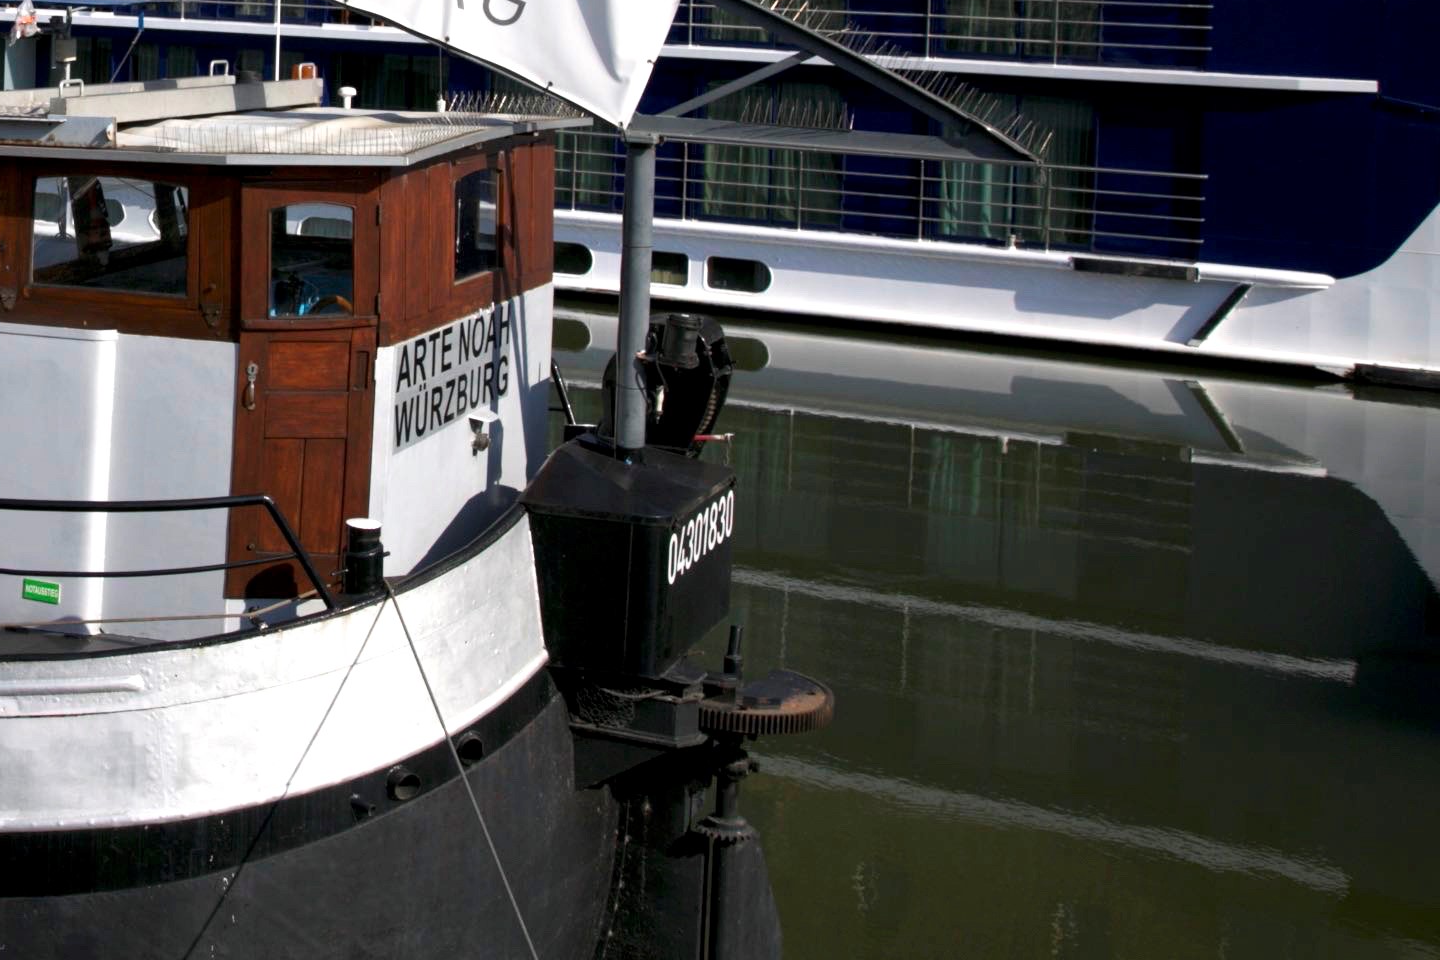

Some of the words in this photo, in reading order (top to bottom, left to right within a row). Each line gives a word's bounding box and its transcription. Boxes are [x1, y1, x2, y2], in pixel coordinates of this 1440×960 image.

[396, 326, 454, 393] ARTE
[458, 304, 509, 366] NOAH
[394, 356, 509, 448] WÜRZBURG
[668, 489, 734, 585] 04301830
